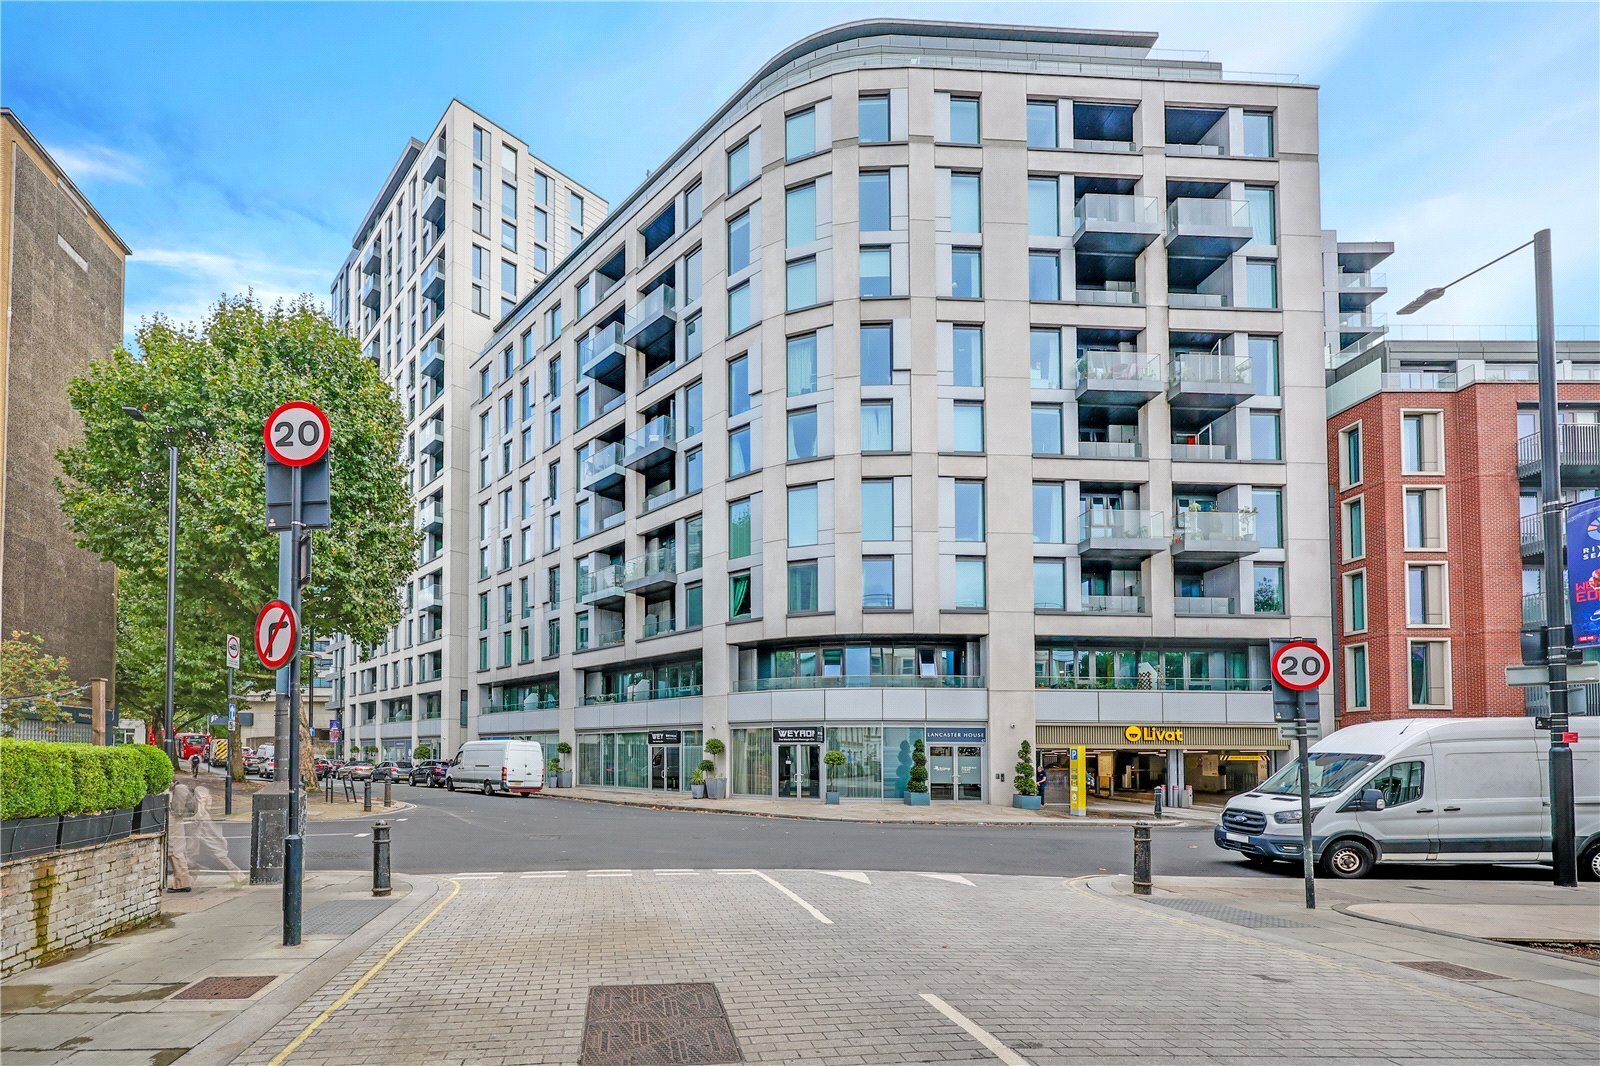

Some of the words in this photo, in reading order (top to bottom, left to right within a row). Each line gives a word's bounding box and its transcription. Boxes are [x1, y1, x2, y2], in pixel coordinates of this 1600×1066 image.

[274, 420, 320, 447] 20
[1281, 656, 1320, 676] 20
[1144, 727, 1184, 741] Livat
